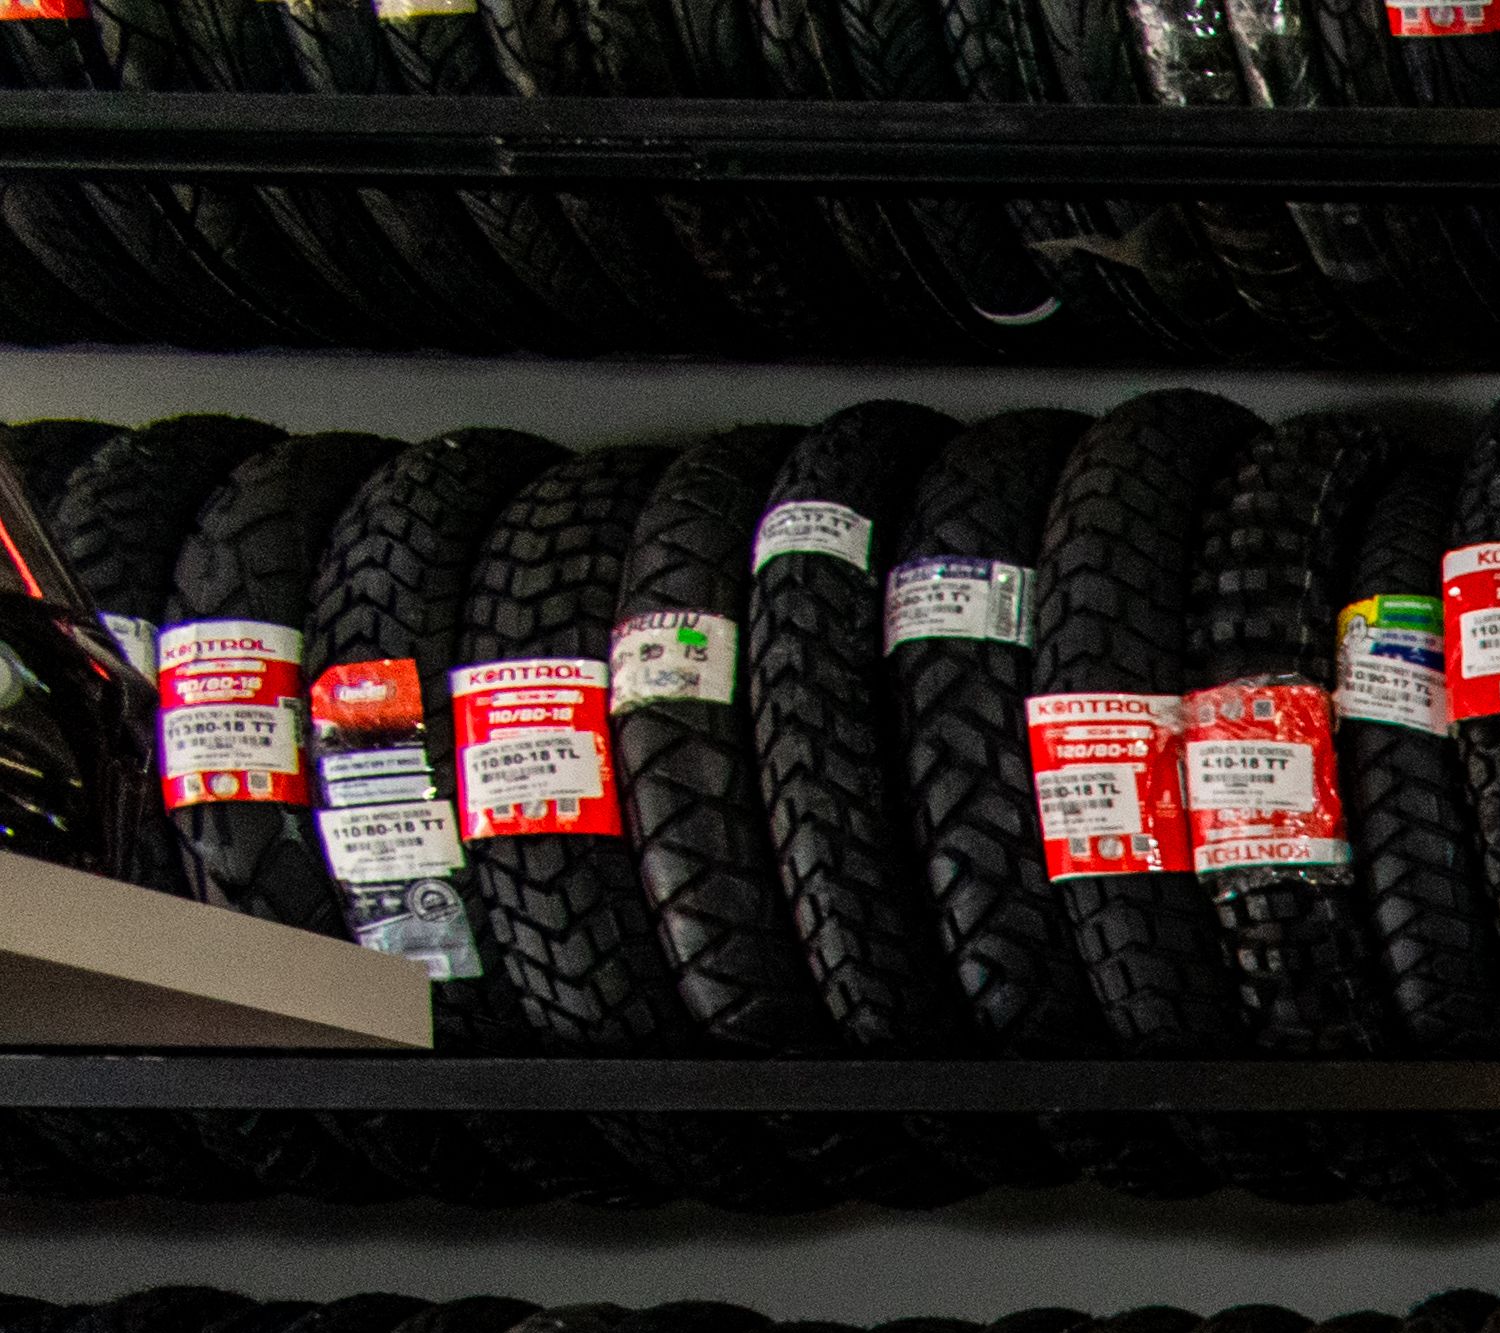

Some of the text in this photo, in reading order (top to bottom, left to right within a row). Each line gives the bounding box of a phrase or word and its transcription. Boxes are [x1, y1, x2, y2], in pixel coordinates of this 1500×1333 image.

[468, 663, 595, 687] KONTROL
[251, 721, 278, 735] TT
[557, 748, 581, 761] TL
[1265, 758, 1289, 771] TT
[1100, 783, 1120, 796] TL
[423, 818, 446, 832] TT
